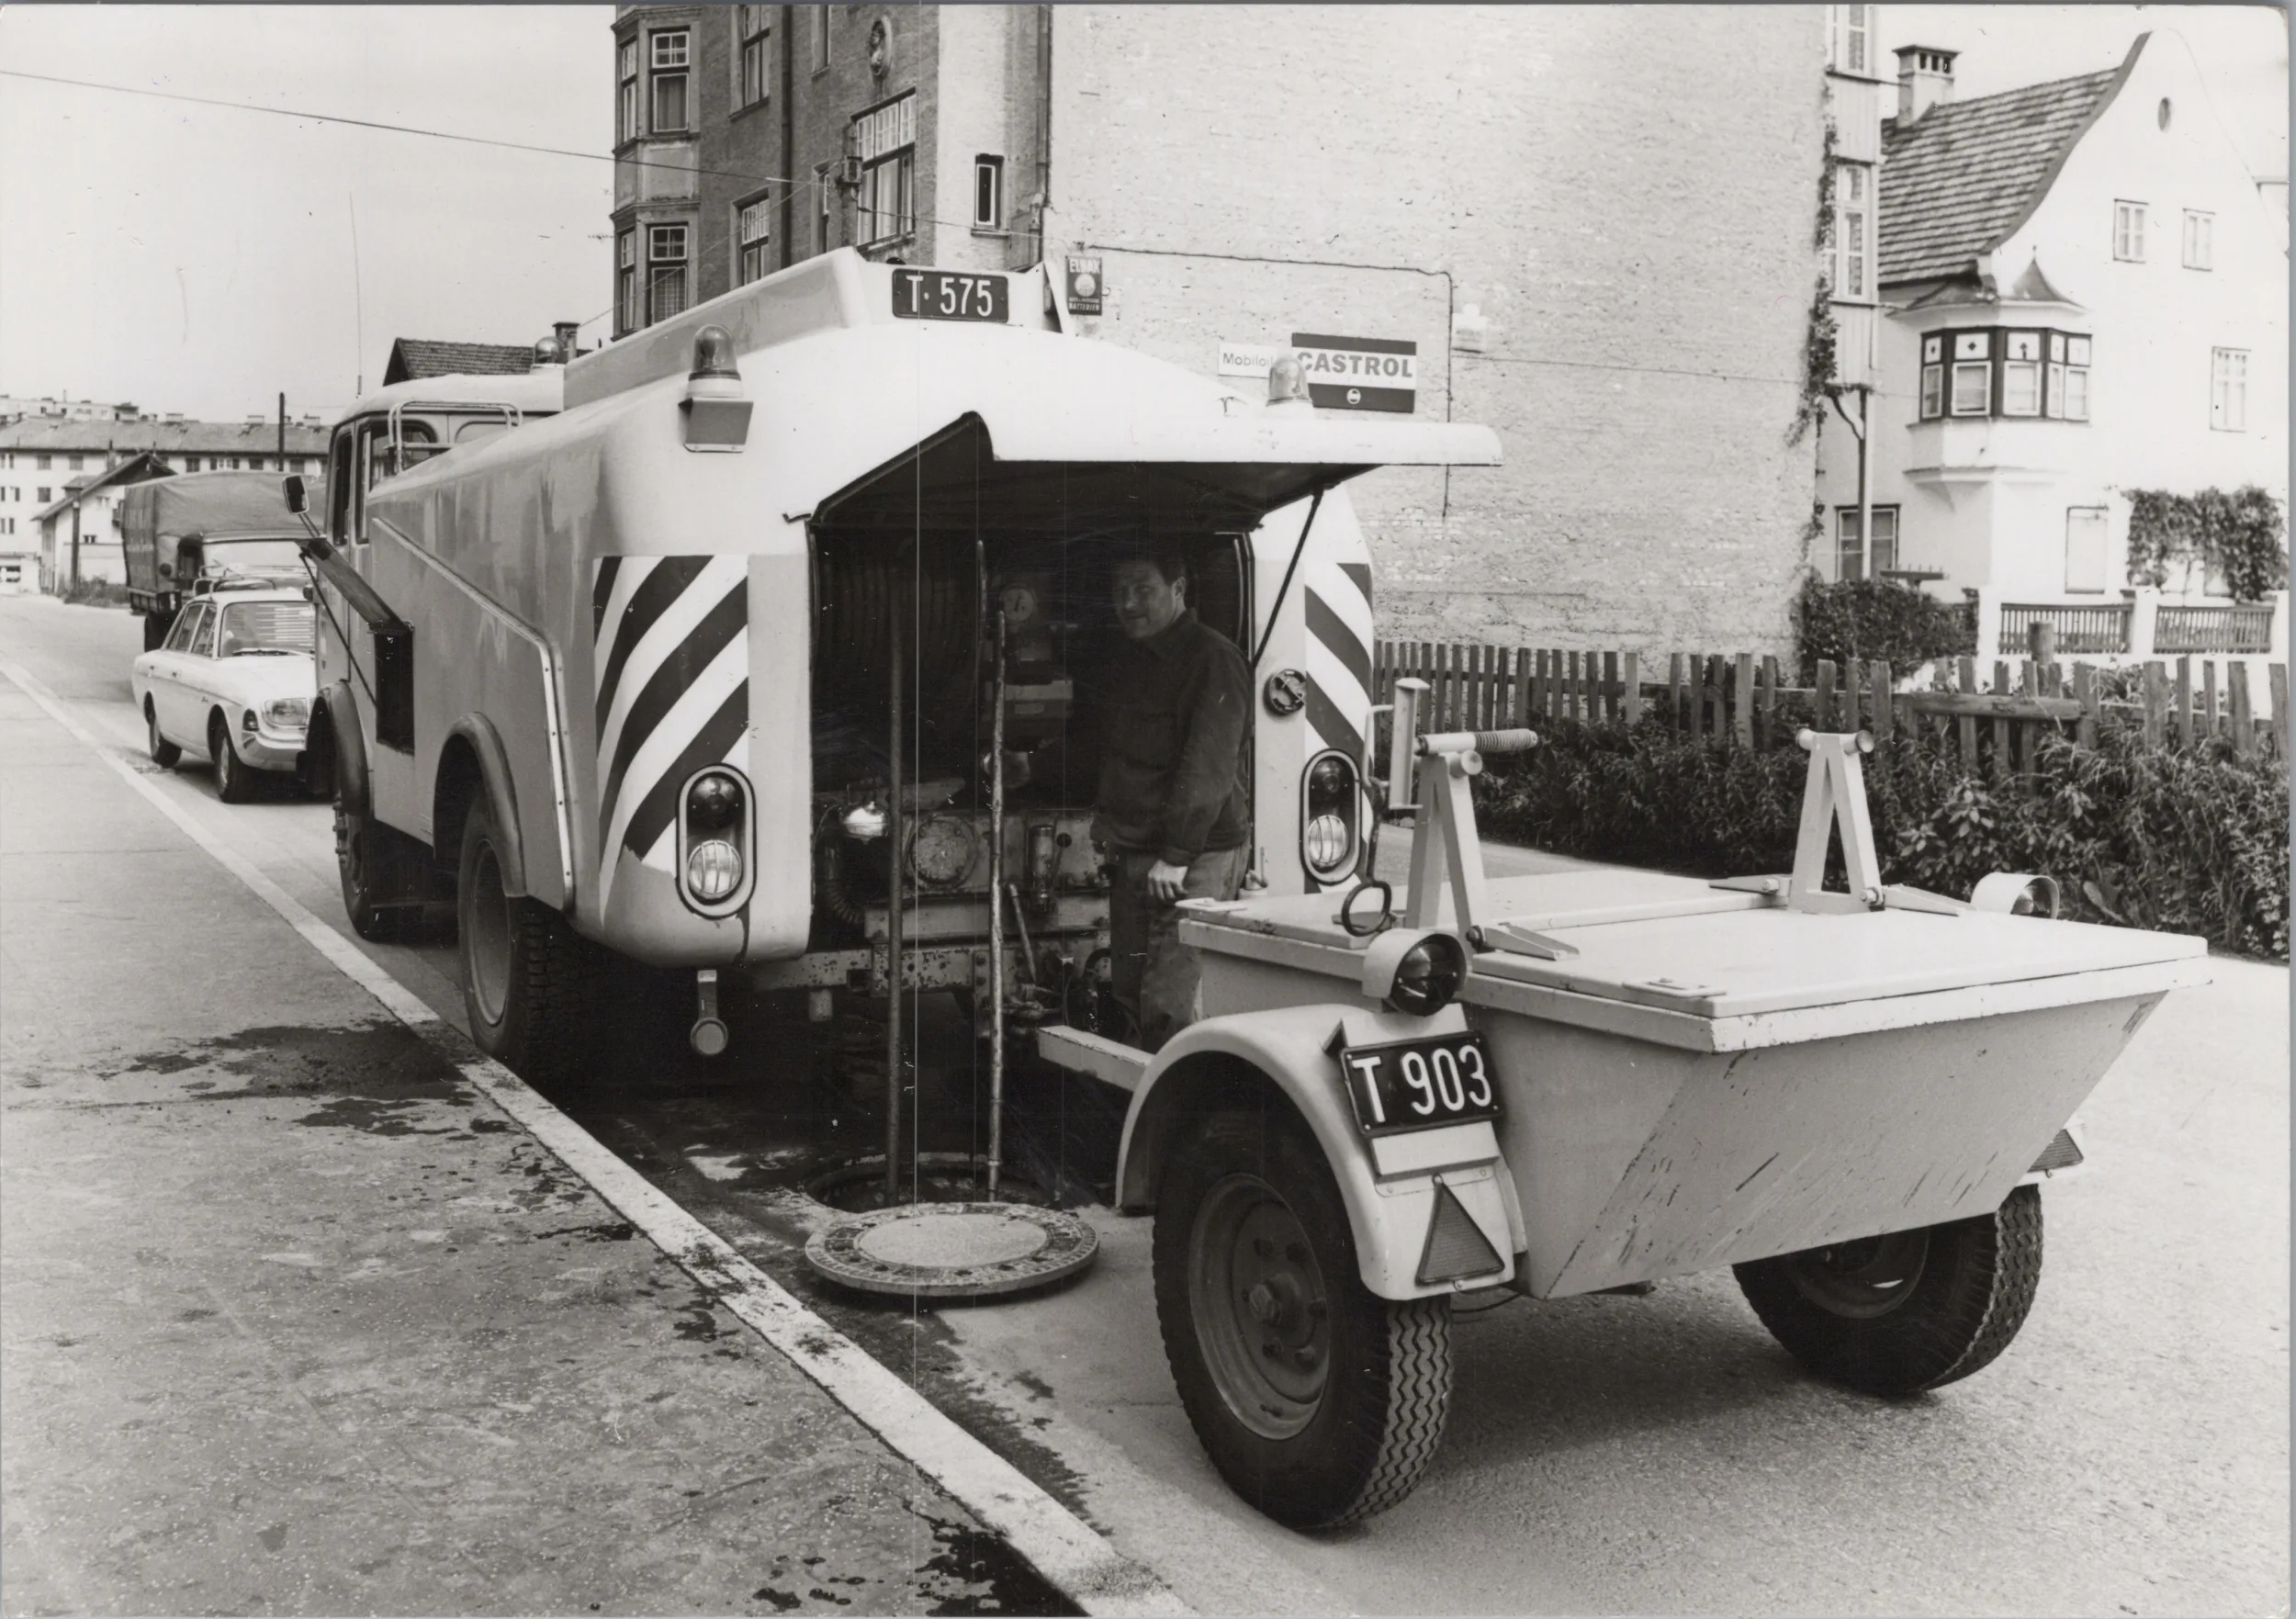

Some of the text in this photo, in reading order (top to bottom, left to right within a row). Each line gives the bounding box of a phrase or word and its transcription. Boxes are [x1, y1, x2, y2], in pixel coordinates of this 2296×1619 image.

[940, 277, 993, 317] 575
[1222, 352, 1275, 367] Mobiloil
[1297, 352, 1412, 377] CASTROL
[1352, 1045, 1491, 1122] T 903
